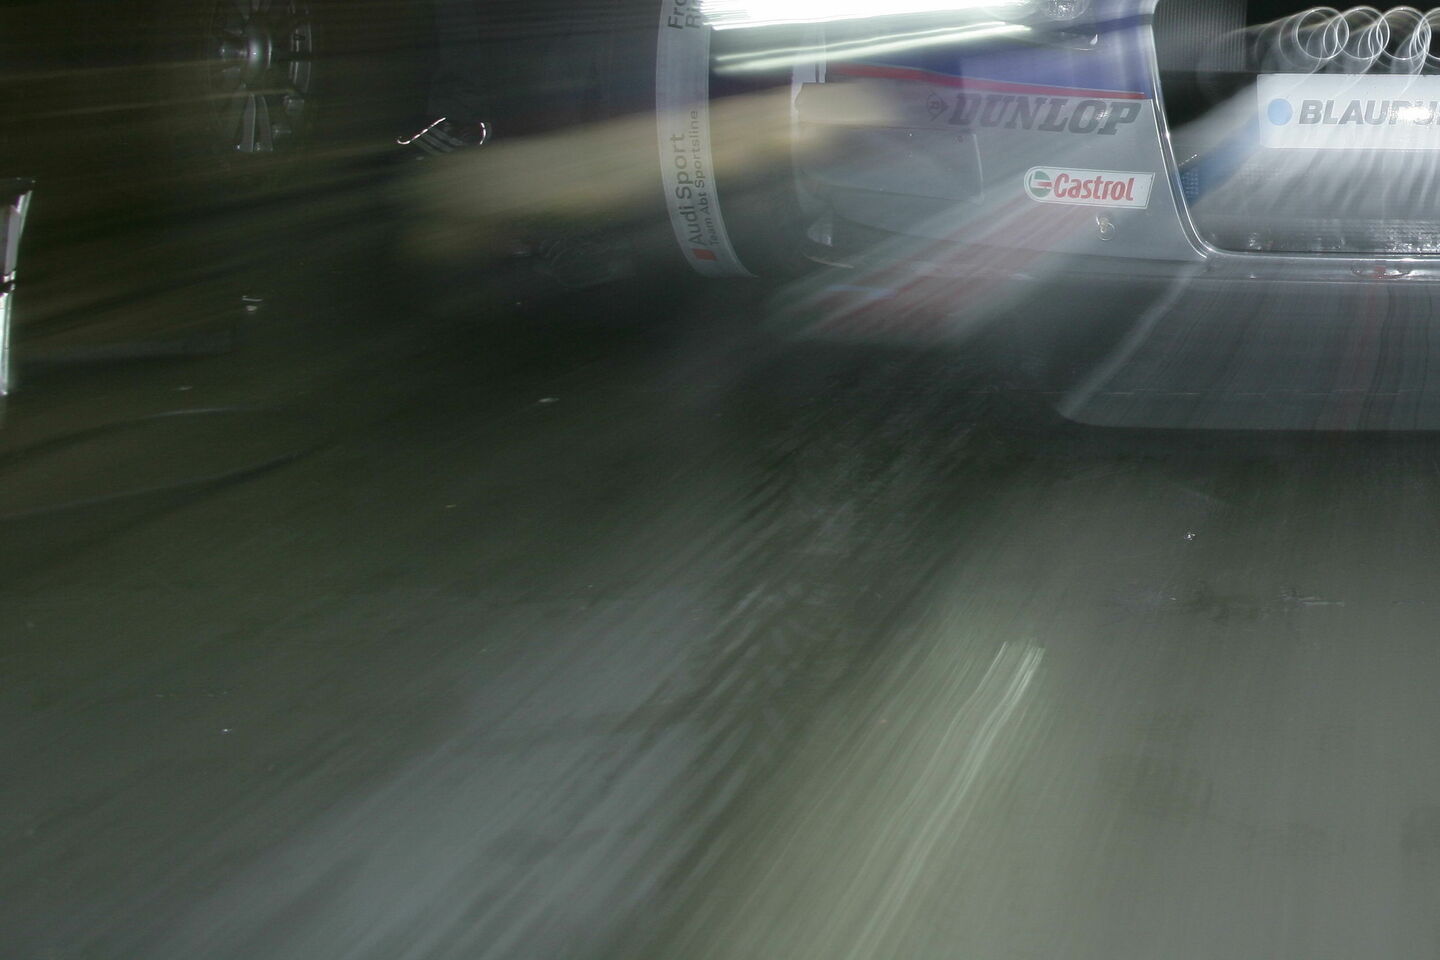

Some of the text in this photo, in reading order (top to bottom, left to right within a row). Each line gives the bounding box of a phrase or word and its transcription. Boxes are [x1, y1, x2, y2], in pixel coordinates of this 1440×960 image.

[948, 93, 1142, 136] DUNLOP
[689, 110, 706, 188] Sportsline
[670, 133, 707, 246] Audi Sport
[1052, 172, 1135, 201] Castrol
